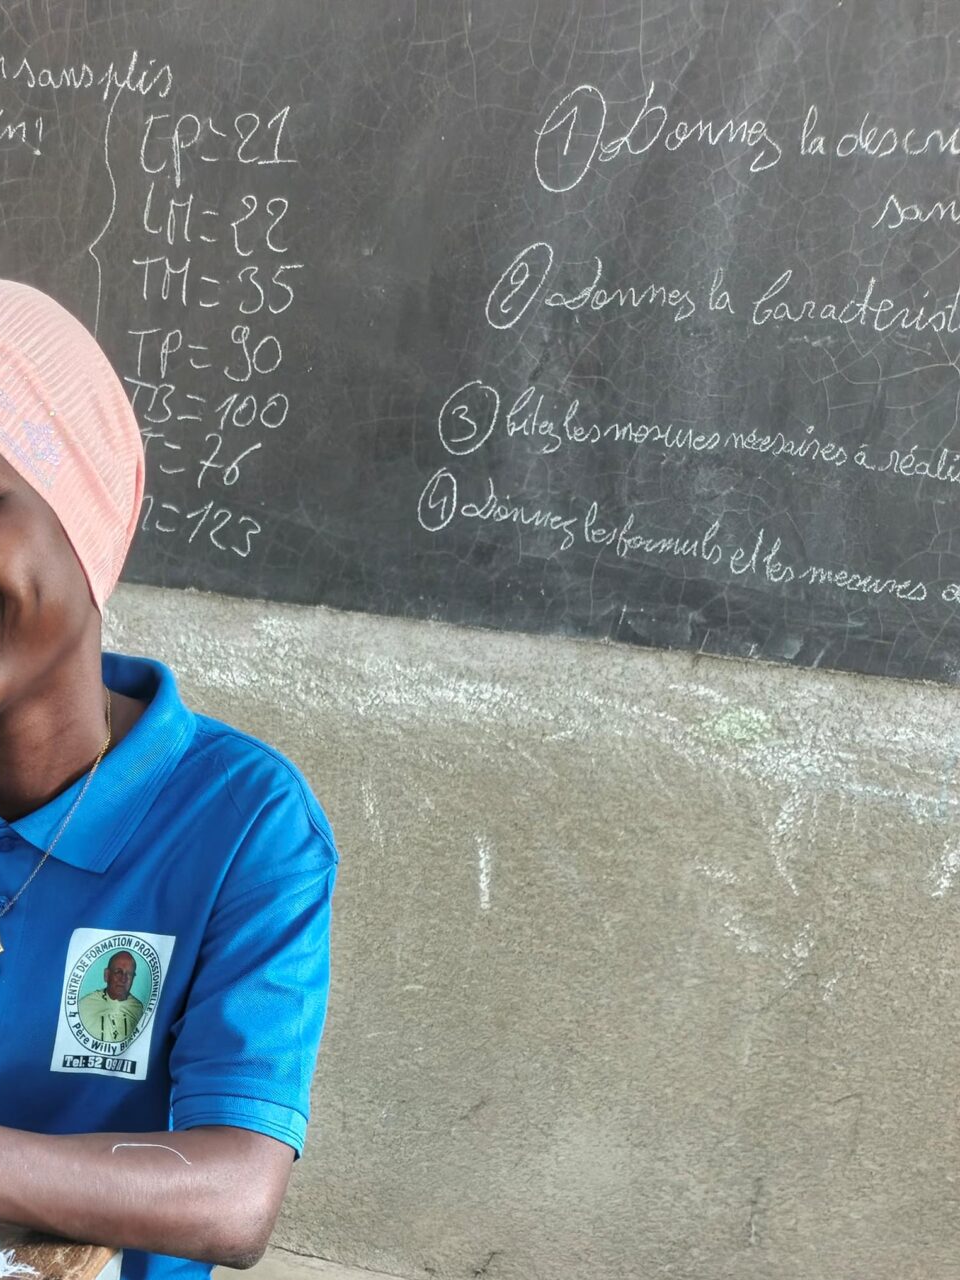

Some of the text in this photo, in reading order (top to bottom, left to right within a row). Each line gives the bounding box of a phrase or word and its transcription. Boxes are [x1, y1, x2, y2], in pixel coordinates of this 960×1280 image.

[13, 57, 95, 89] sans
[67, 972, 82, 1006] CENTRE
[76, 959, 90, 973] DE
[86, 937, 133, 962] FORMATION
[91, 1039, 118, 1056] Willy
[64, 1056, 86, 1067] Tel:
[87, 1056, 103, 1068] 52
